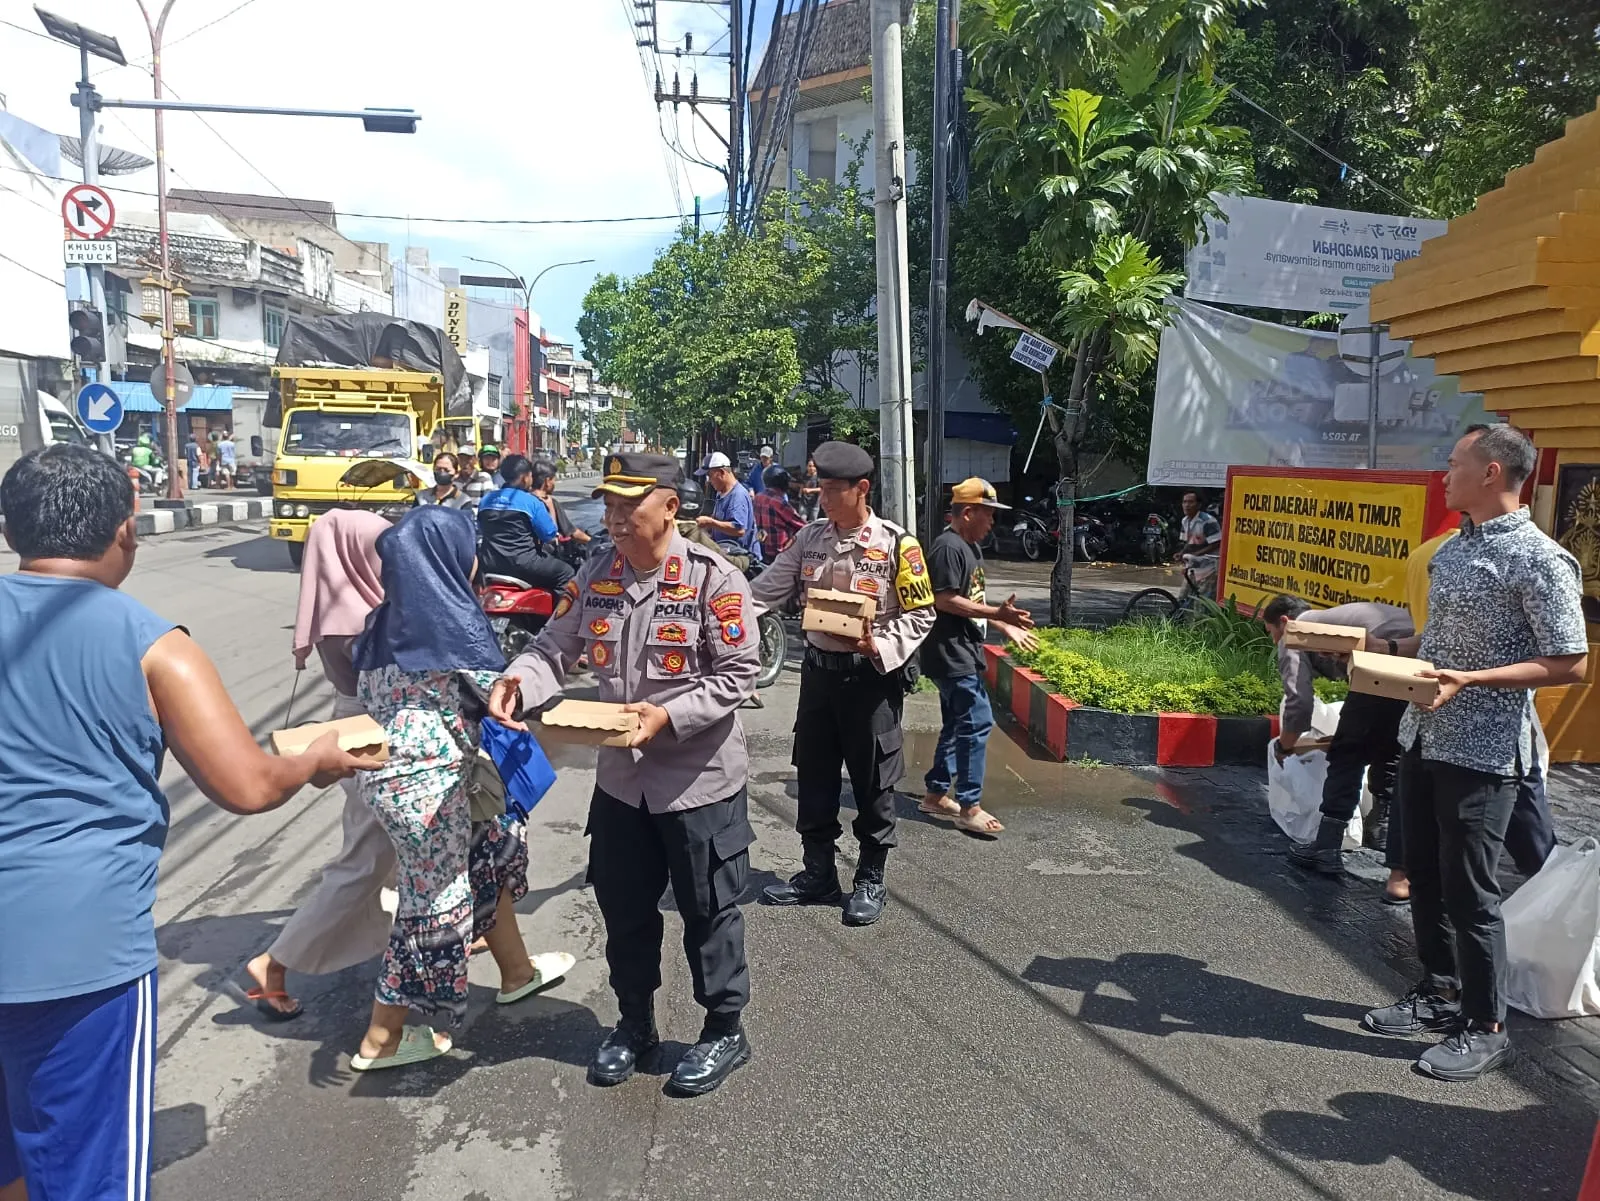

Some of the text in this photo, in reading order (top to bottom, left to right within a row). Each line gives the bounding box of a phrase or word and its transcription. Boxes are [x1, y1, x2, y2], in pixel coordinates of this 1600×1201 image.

[67, 243, 113, 251] KHUSUS
[68, 252, 113, 261] TRUCK
[0, 424, 18, 437] GO
[1243, 493, 1401, 528] POLRI DAERAH JAWA TIMUR
[1235, 516, 1410, 560] RESOR KOTA BESAR SURABAYA
[855, 562, 888, 576] POLRI
[1255, 544, 1370, 585] SEKTOR SIMOKERTO
[1228, 563, 1249, 581] Jalan
[1250, 567, 1285, 589] Kapasan
[1286, 575, 1300, 593] No.
[1303, 579, 1321, 599] 192
[654, 602, 698, 619] POLRI
